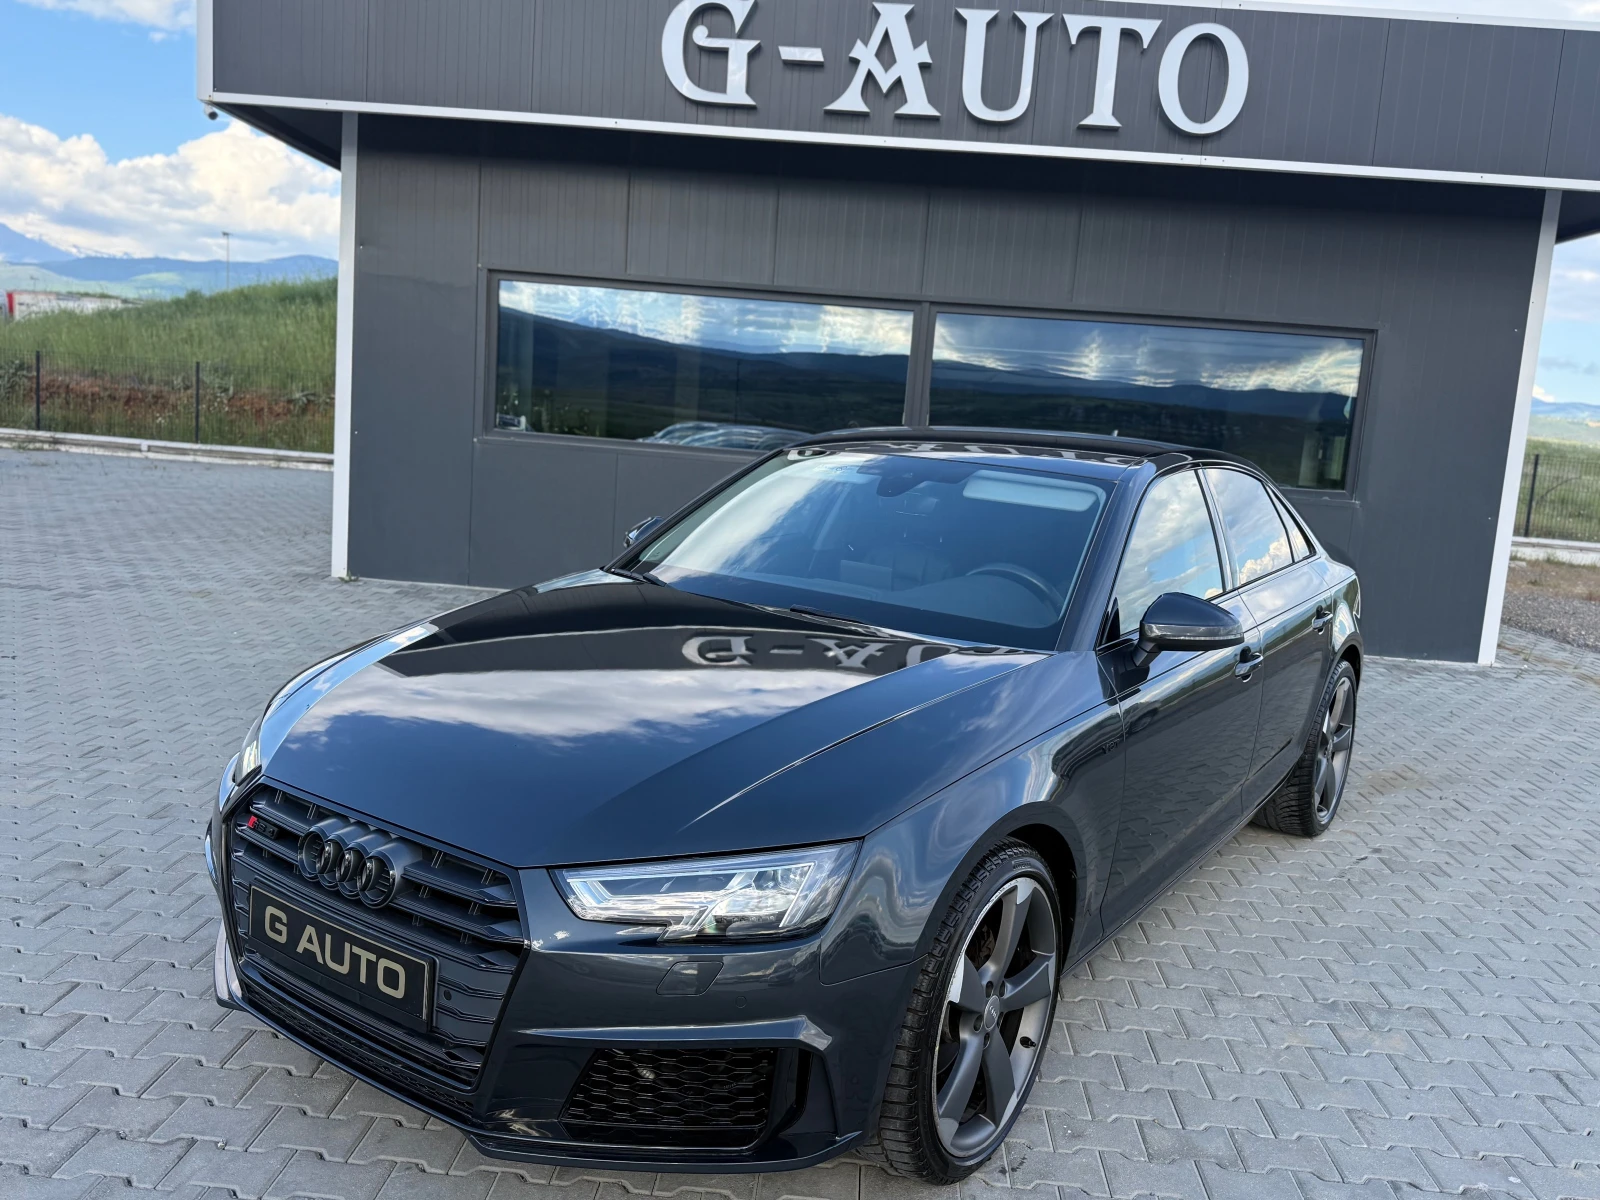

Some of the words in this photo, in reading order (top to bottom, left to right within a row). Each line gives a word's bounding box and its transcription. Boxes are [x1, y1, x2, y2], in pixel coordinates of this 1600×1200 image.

[661, 0, 1250, 136] G-AUTO
[264, 905, 288, 944] G
[296, 924, 406, 999] AUTO
